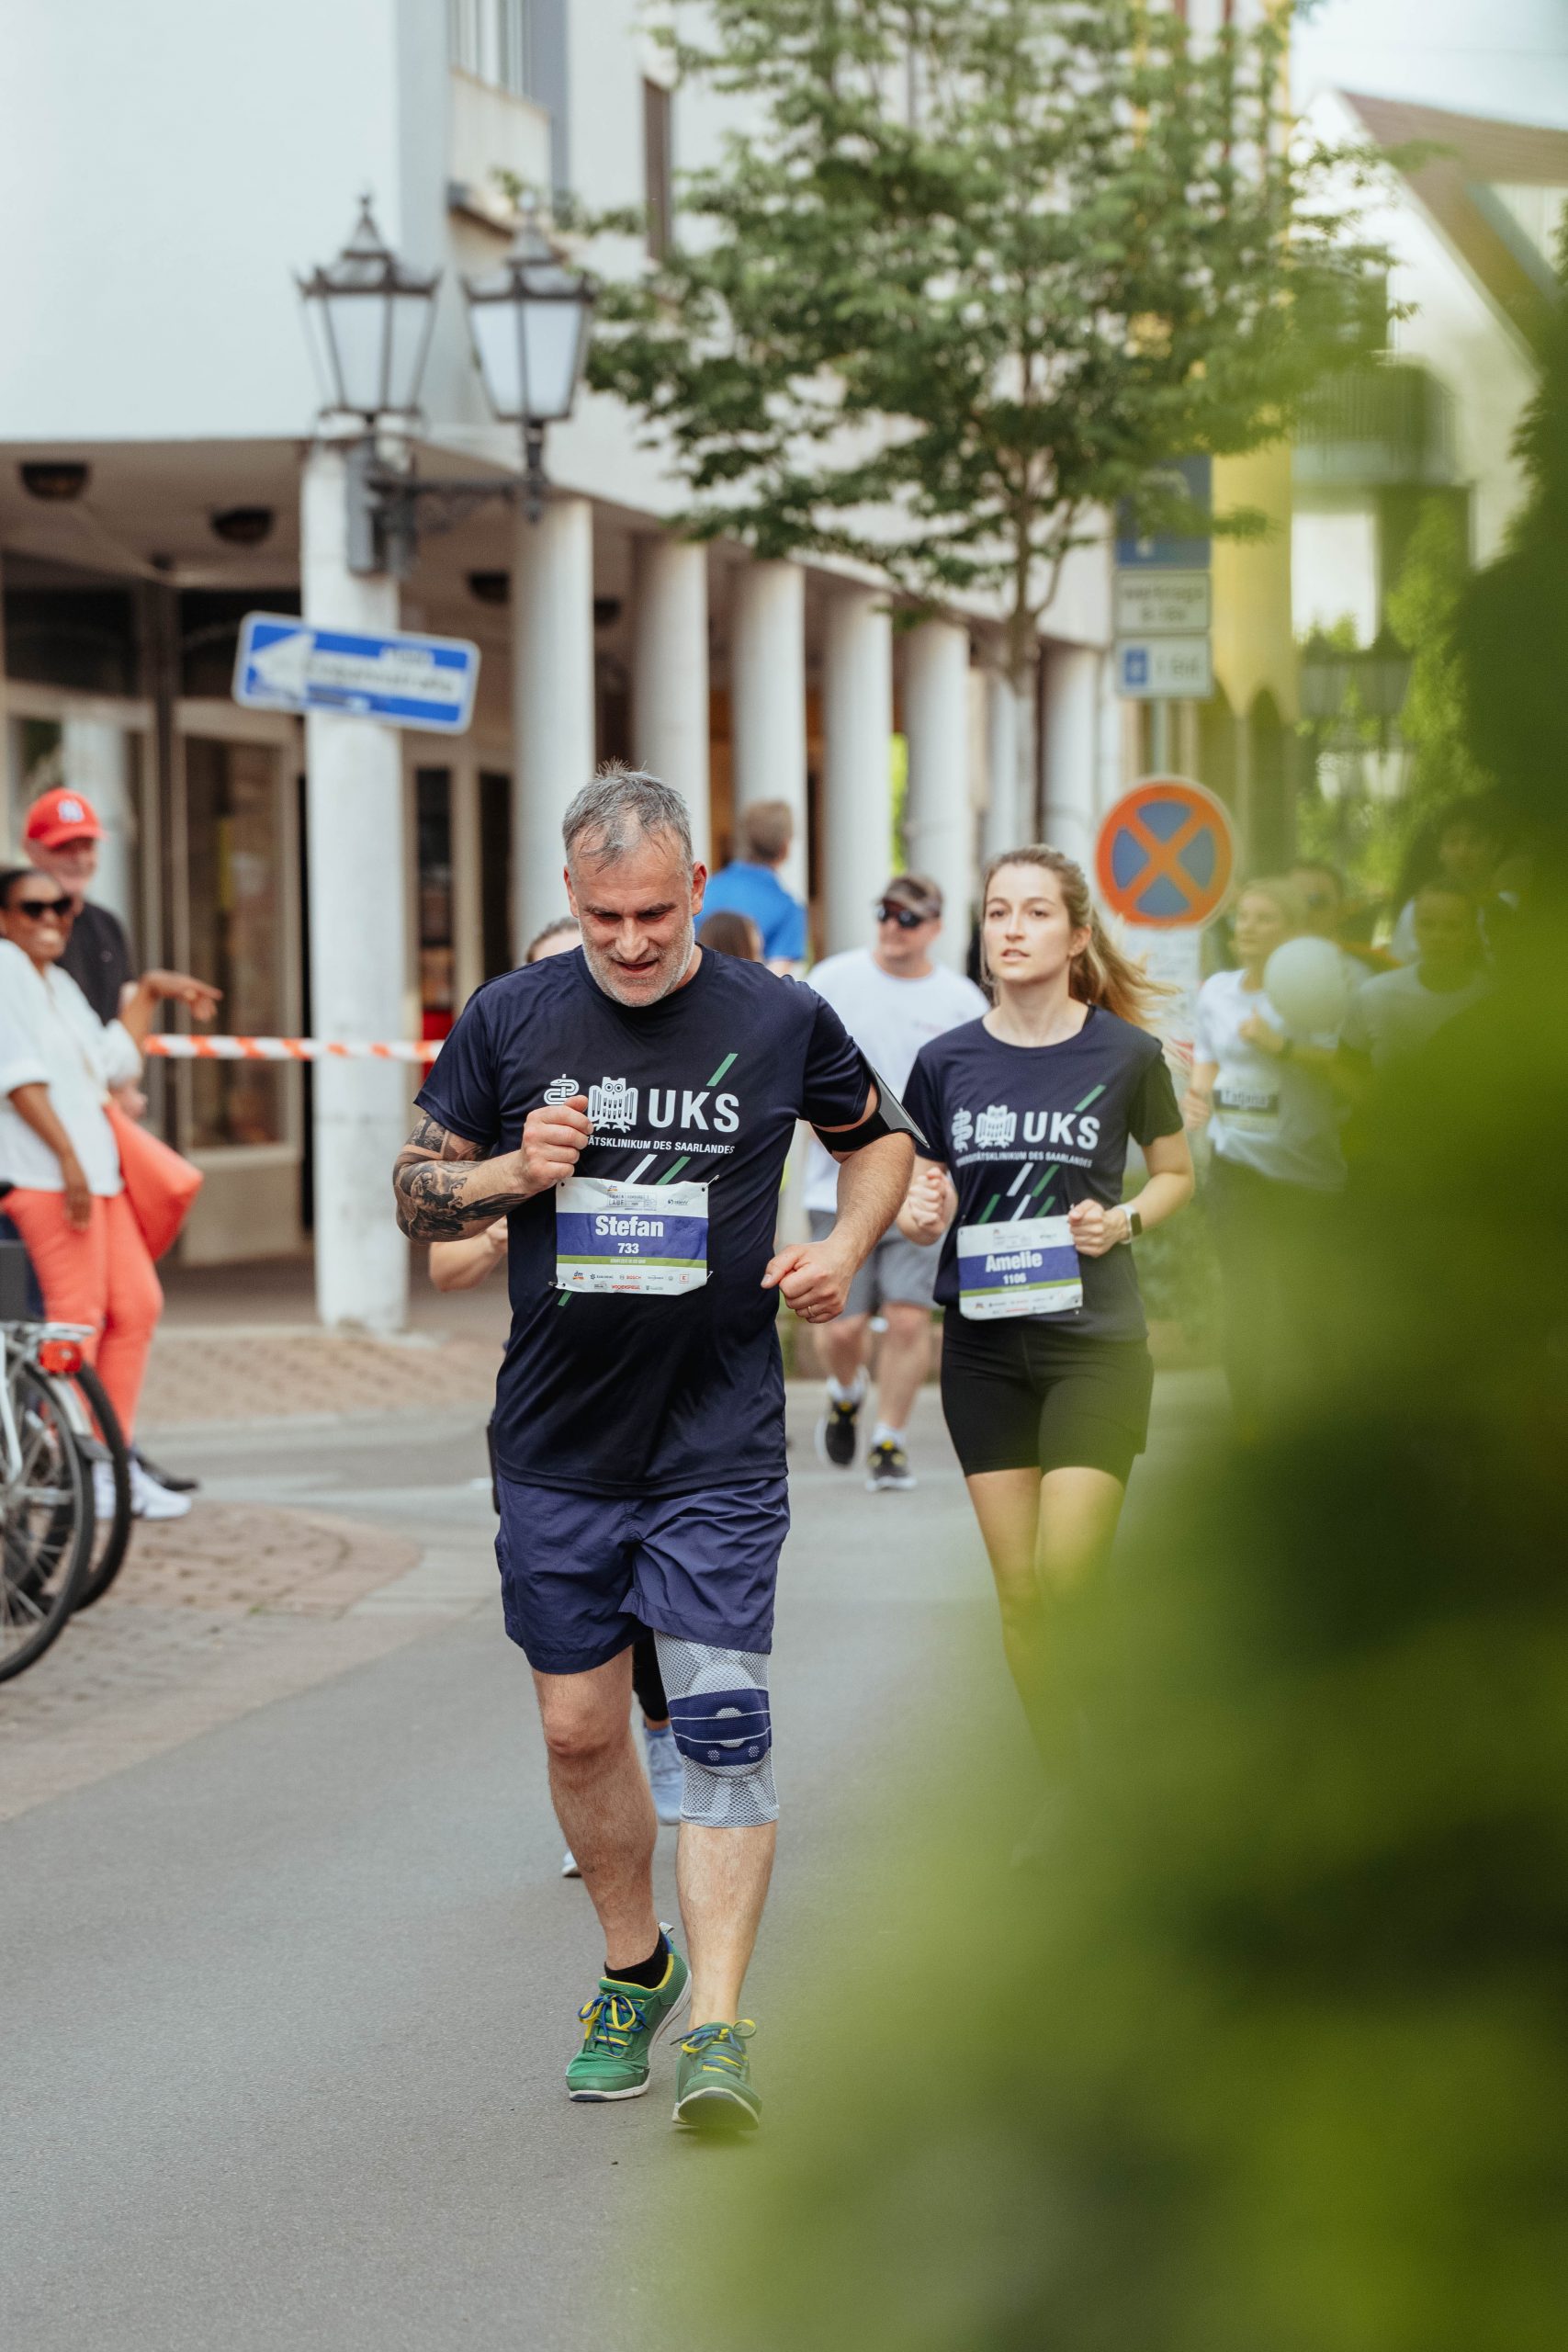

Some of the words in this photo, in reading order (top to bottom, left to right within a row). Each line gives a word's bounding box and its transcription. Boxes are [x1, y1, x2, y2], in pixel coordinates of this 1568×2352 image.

[648, 1089, 739, 1133] UKS
[1022, 1111, 1100, 1150] UKS
[586, 1136, 650, 1149] ÄTSKLINIKUM
[653, 1140, 672, 1150] DES
[674, 1141, 735, 1154] SAARLANDES
[1028, 1150, 1044, 1161] DES
[595, 1216, 663, 1238] Stefan
[617, 1242, 639, 1254] 733
[986, 1250, 1043, 1273] Amelie
